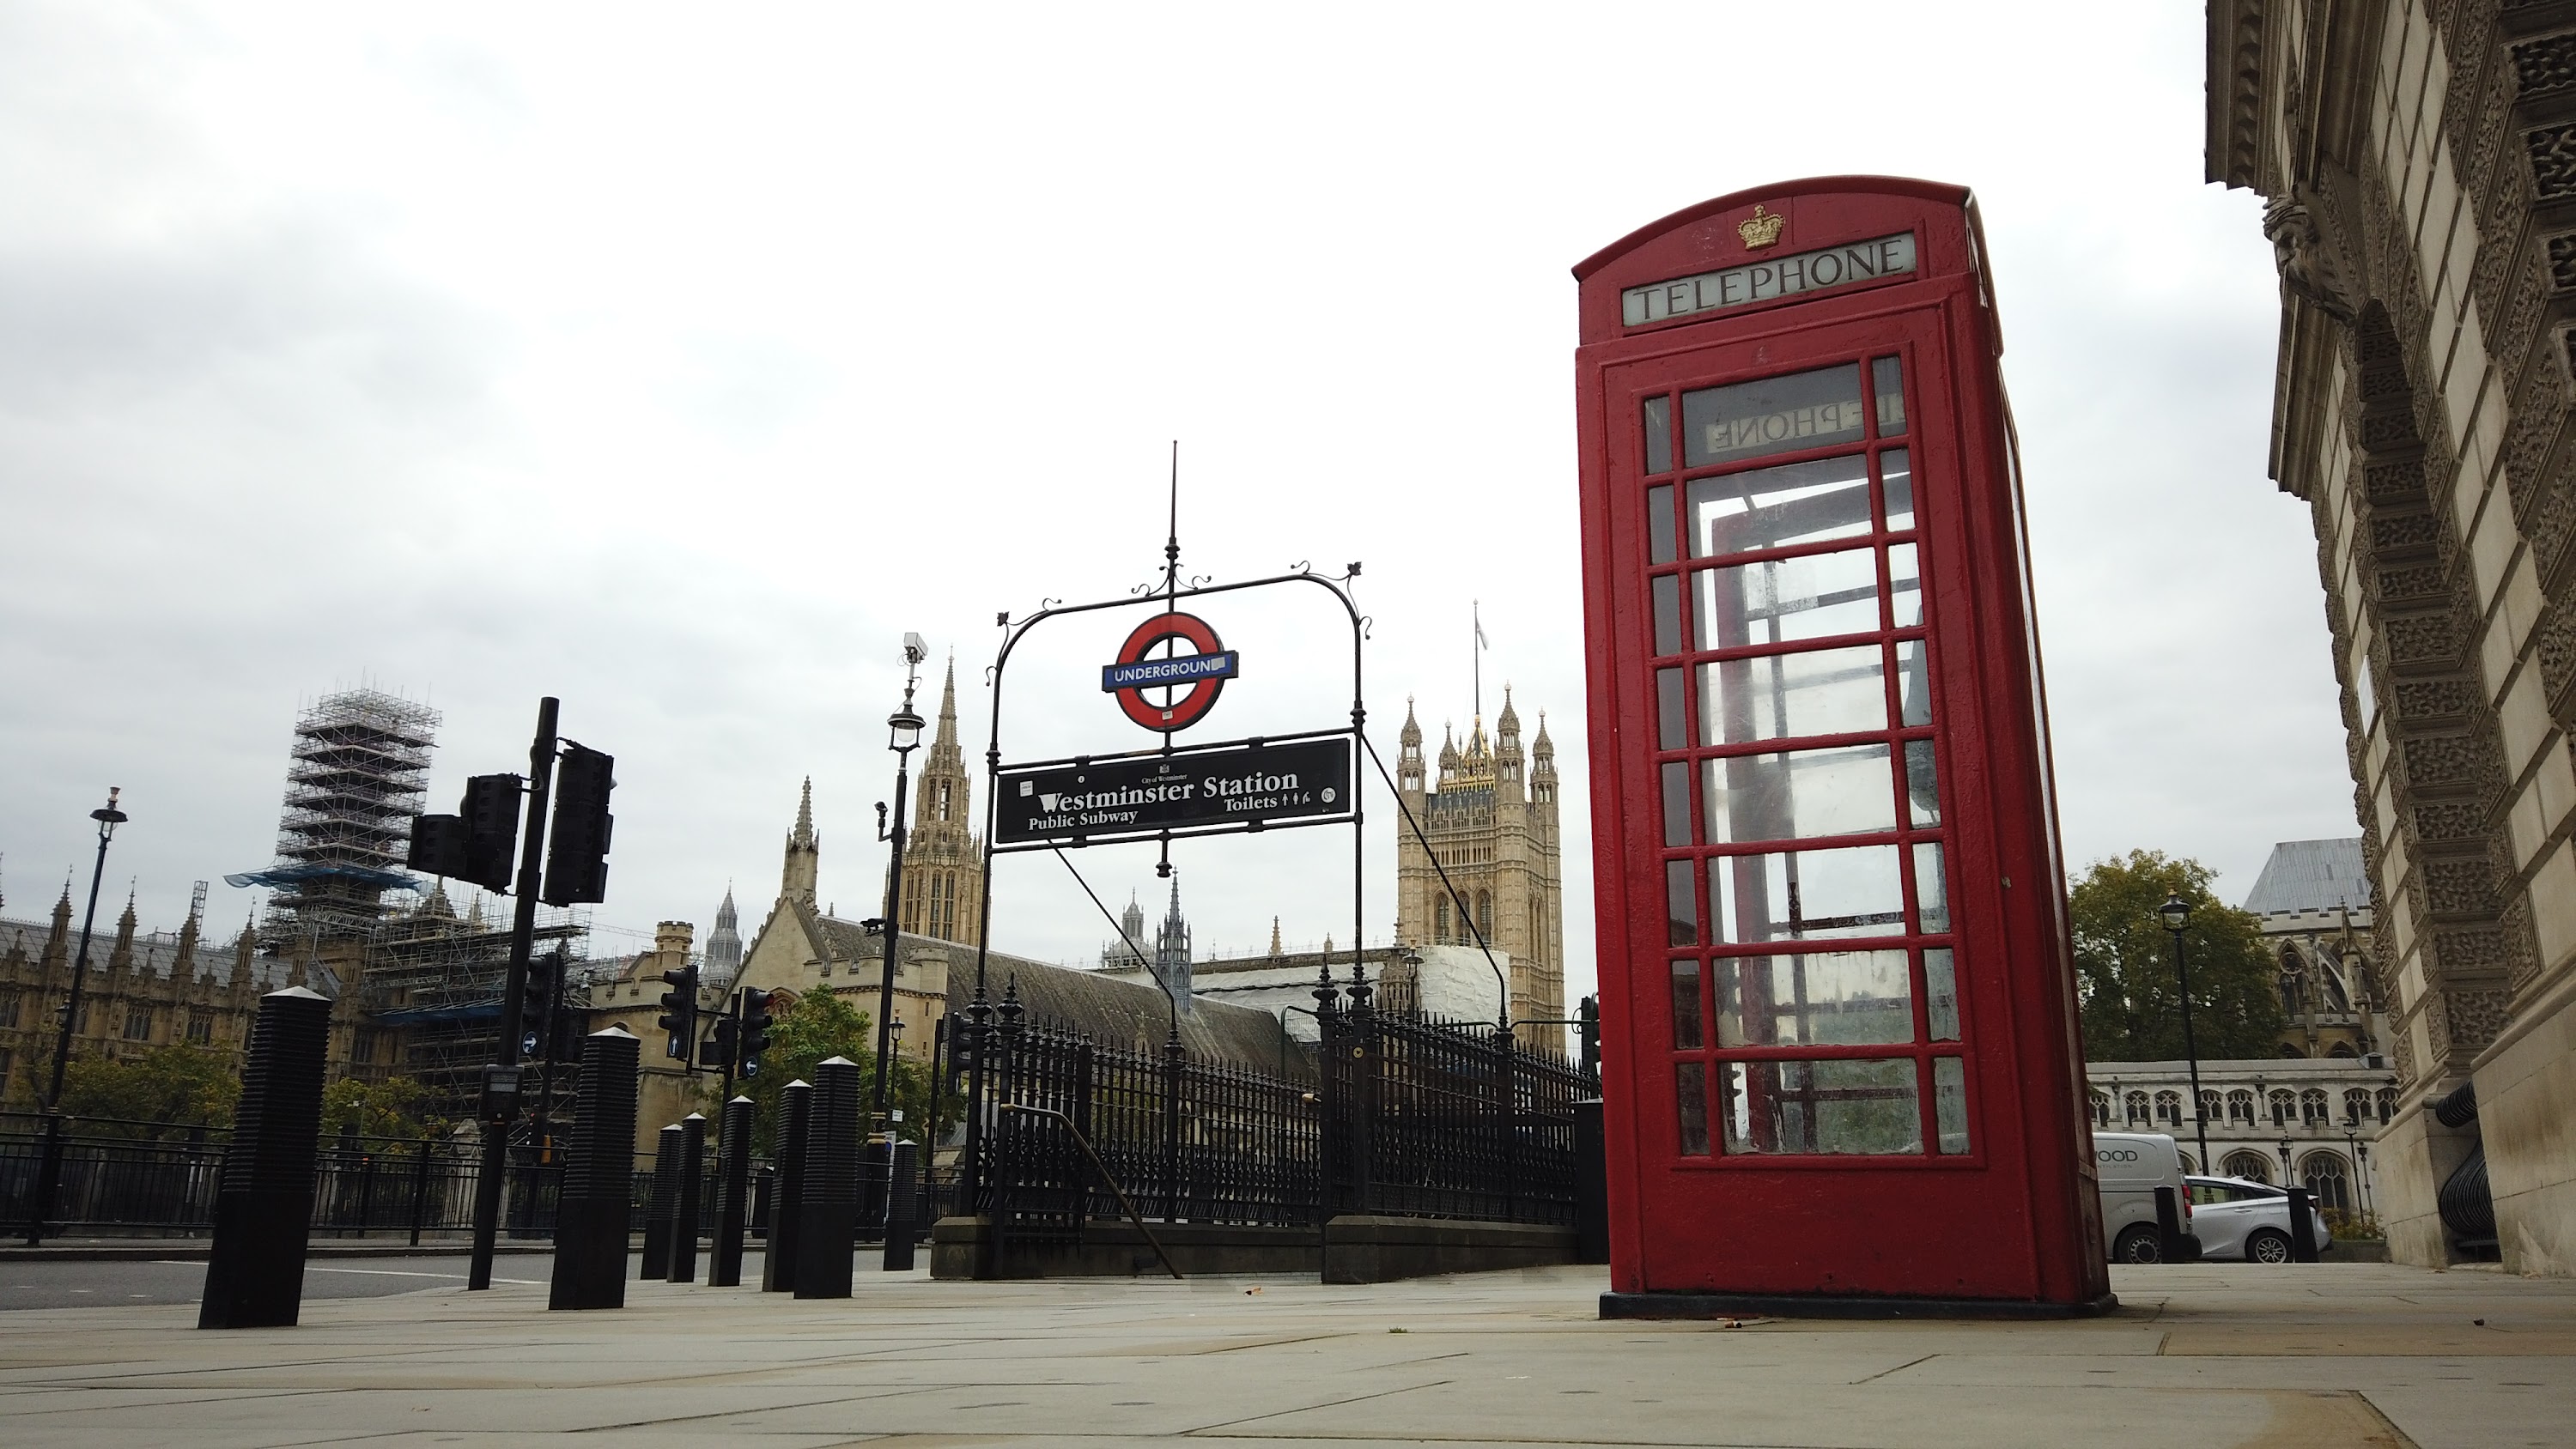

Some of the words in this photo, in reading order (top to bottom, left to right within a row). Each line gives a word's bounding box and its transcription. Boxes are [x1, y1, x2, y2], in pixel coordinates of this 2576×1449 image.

[1632, 239, 1904, 320] TELEPHONE
[1141, 777, 1151, 785] City
[1038, 783, 1195, 813] Westminster
[1203, 772, 1300, 798] Station
[1224, 796, 1278, 812] Toilets
[1028, 814, 1075, 831] Public
[1079, 810, 1139, 825] Subway
[2095, 1150, 2138, 1162] OOD
